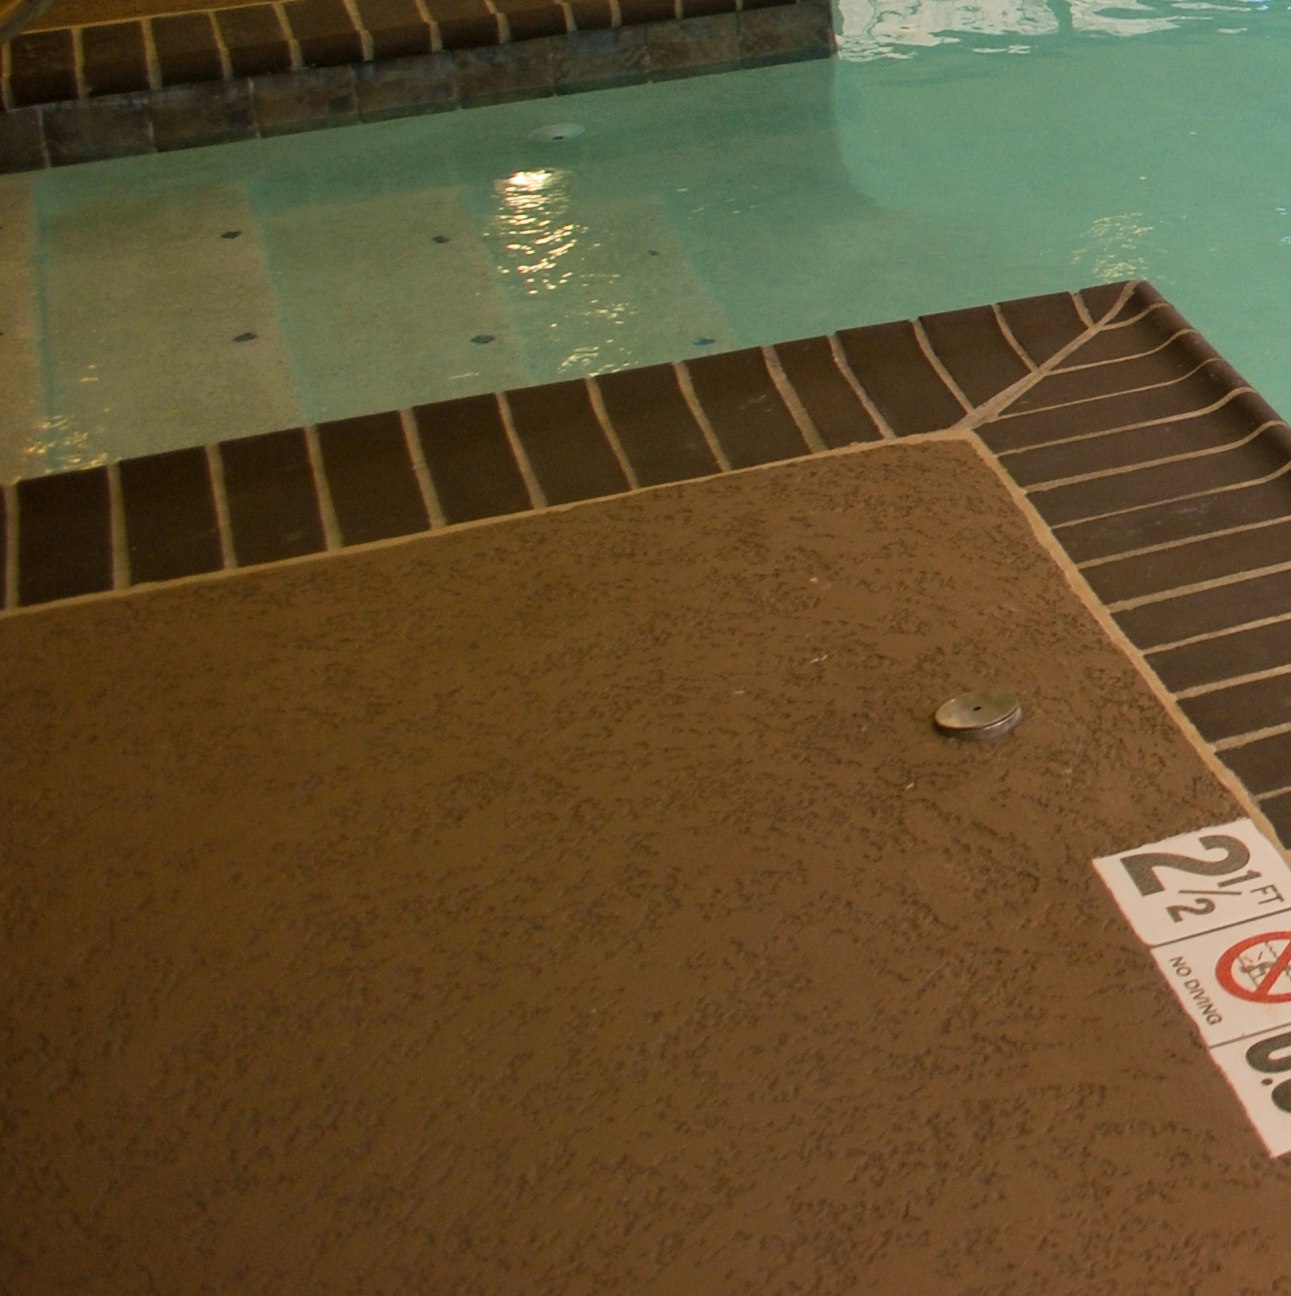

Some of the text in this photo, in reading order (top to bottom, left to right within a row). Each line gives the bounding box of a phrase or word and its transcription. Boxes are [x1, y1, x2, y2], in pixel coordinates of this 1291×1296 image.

[1250, 885, 1285, 905] FT
[1169, 956, 1223, 1026] NO DIVING
